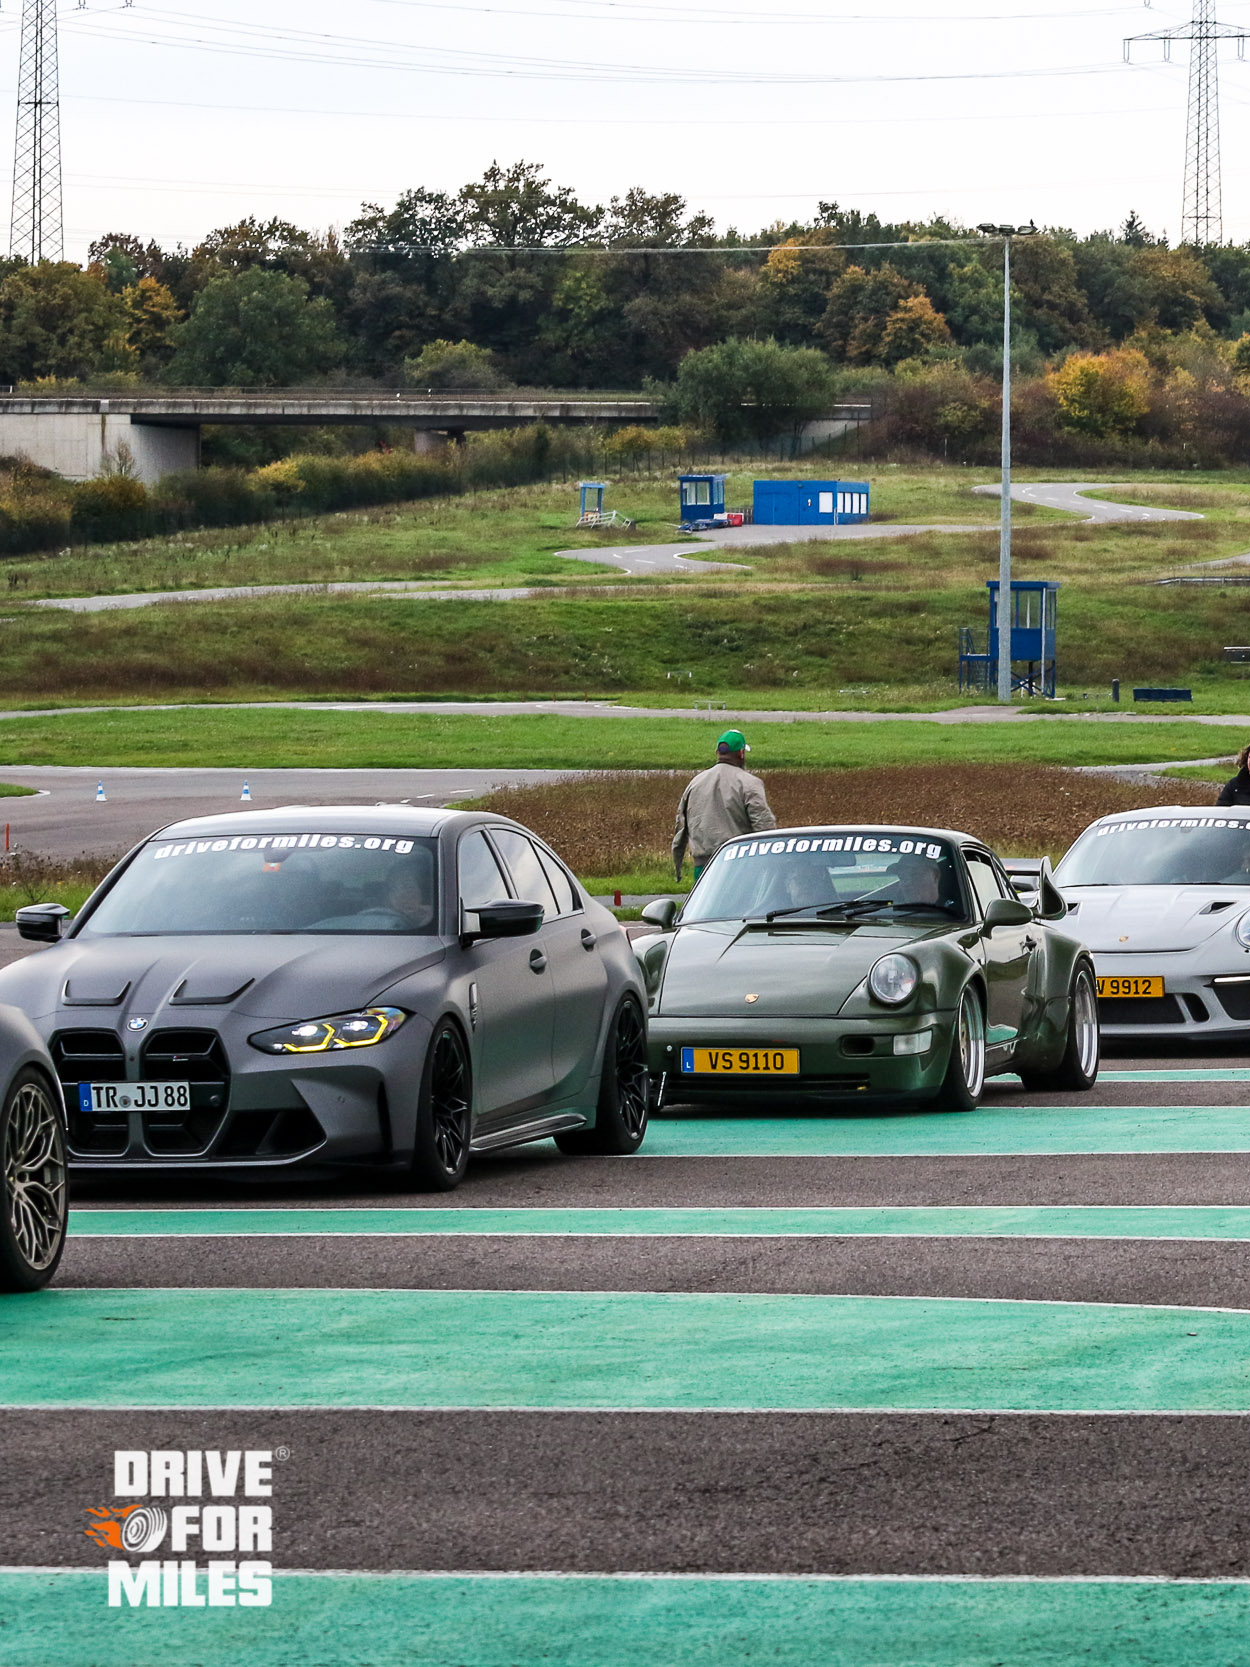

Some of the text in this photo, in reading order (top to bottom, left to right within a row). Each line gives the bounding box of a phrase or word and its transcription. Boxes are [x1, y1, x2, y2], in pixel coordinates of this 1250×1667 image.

[154, 834, 414, 860] driveformiles.org
[723, 836, 942, 861] driveformiles.org
[1110, 979, 1152, 995] 9912
[708, 1051, 733, 1070] VS
[738, 1052, 784, 1071] 9110
[92, 1086, 118, 1108] TR
